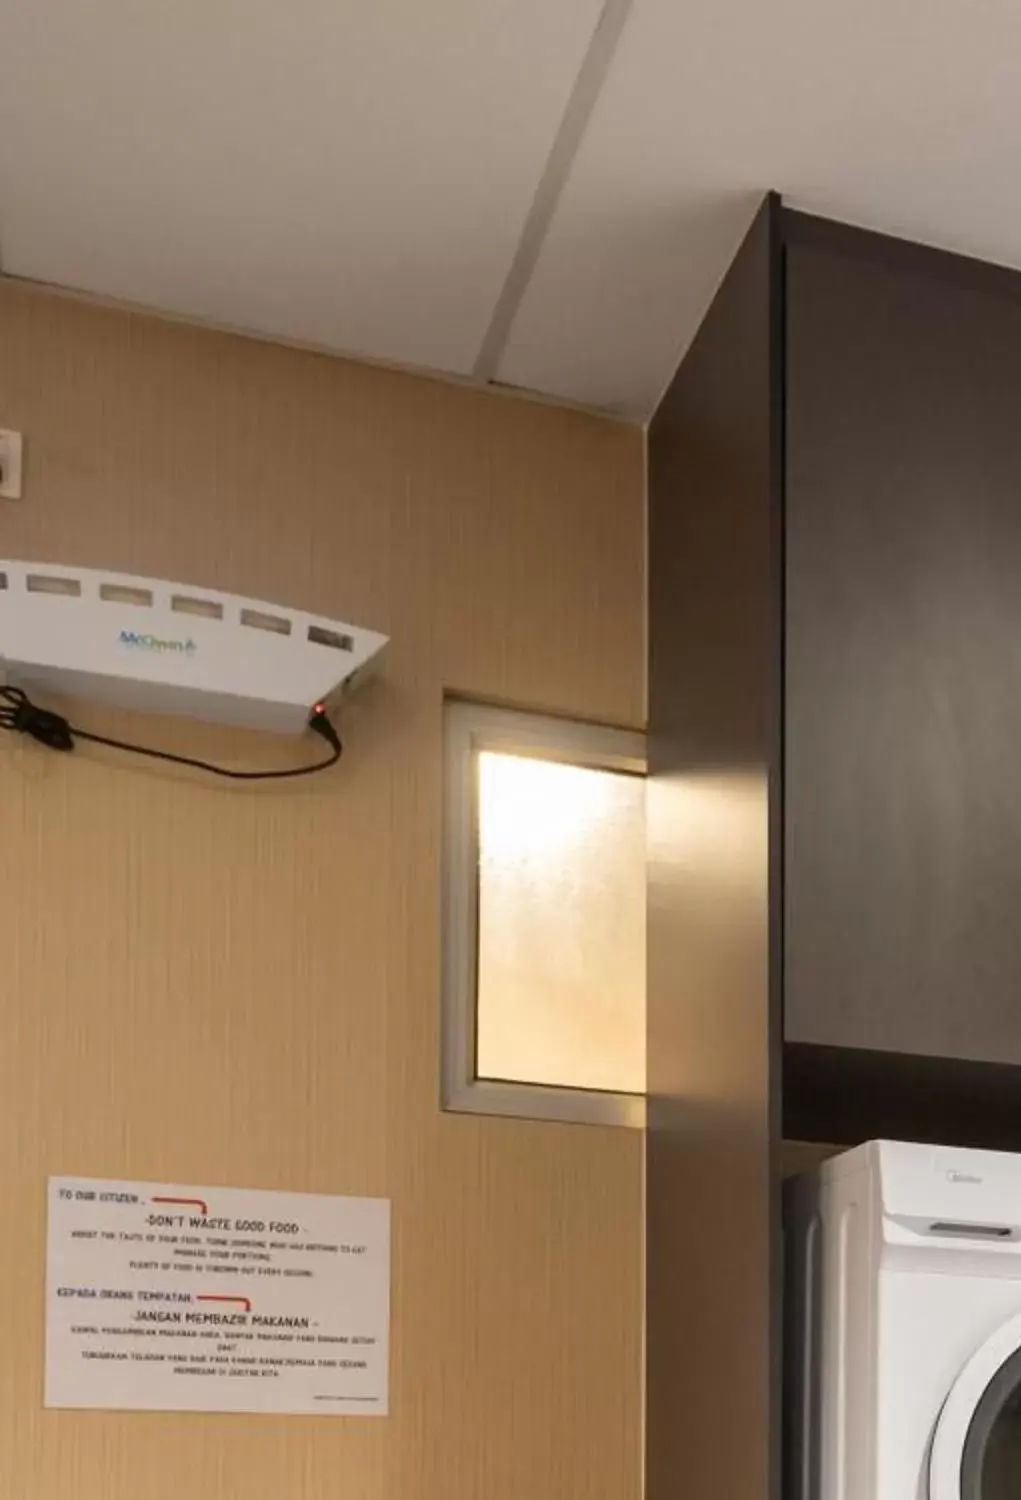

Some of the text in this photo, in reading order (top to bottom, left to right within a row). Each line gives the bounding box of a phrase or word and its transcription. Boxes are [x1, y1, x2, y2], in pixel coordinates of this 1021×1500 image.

[59, 1189, 72, 1200] TO
[189, 1216, 231, 1231] WASTE
[235, 1219, 265, 1232] GOOD
[269, 1222, 299, 1234] FOOD
[185, 1312, 247, 1326] MEMBAZIR
[252, 1315, 309, 1328] MAKANAN
